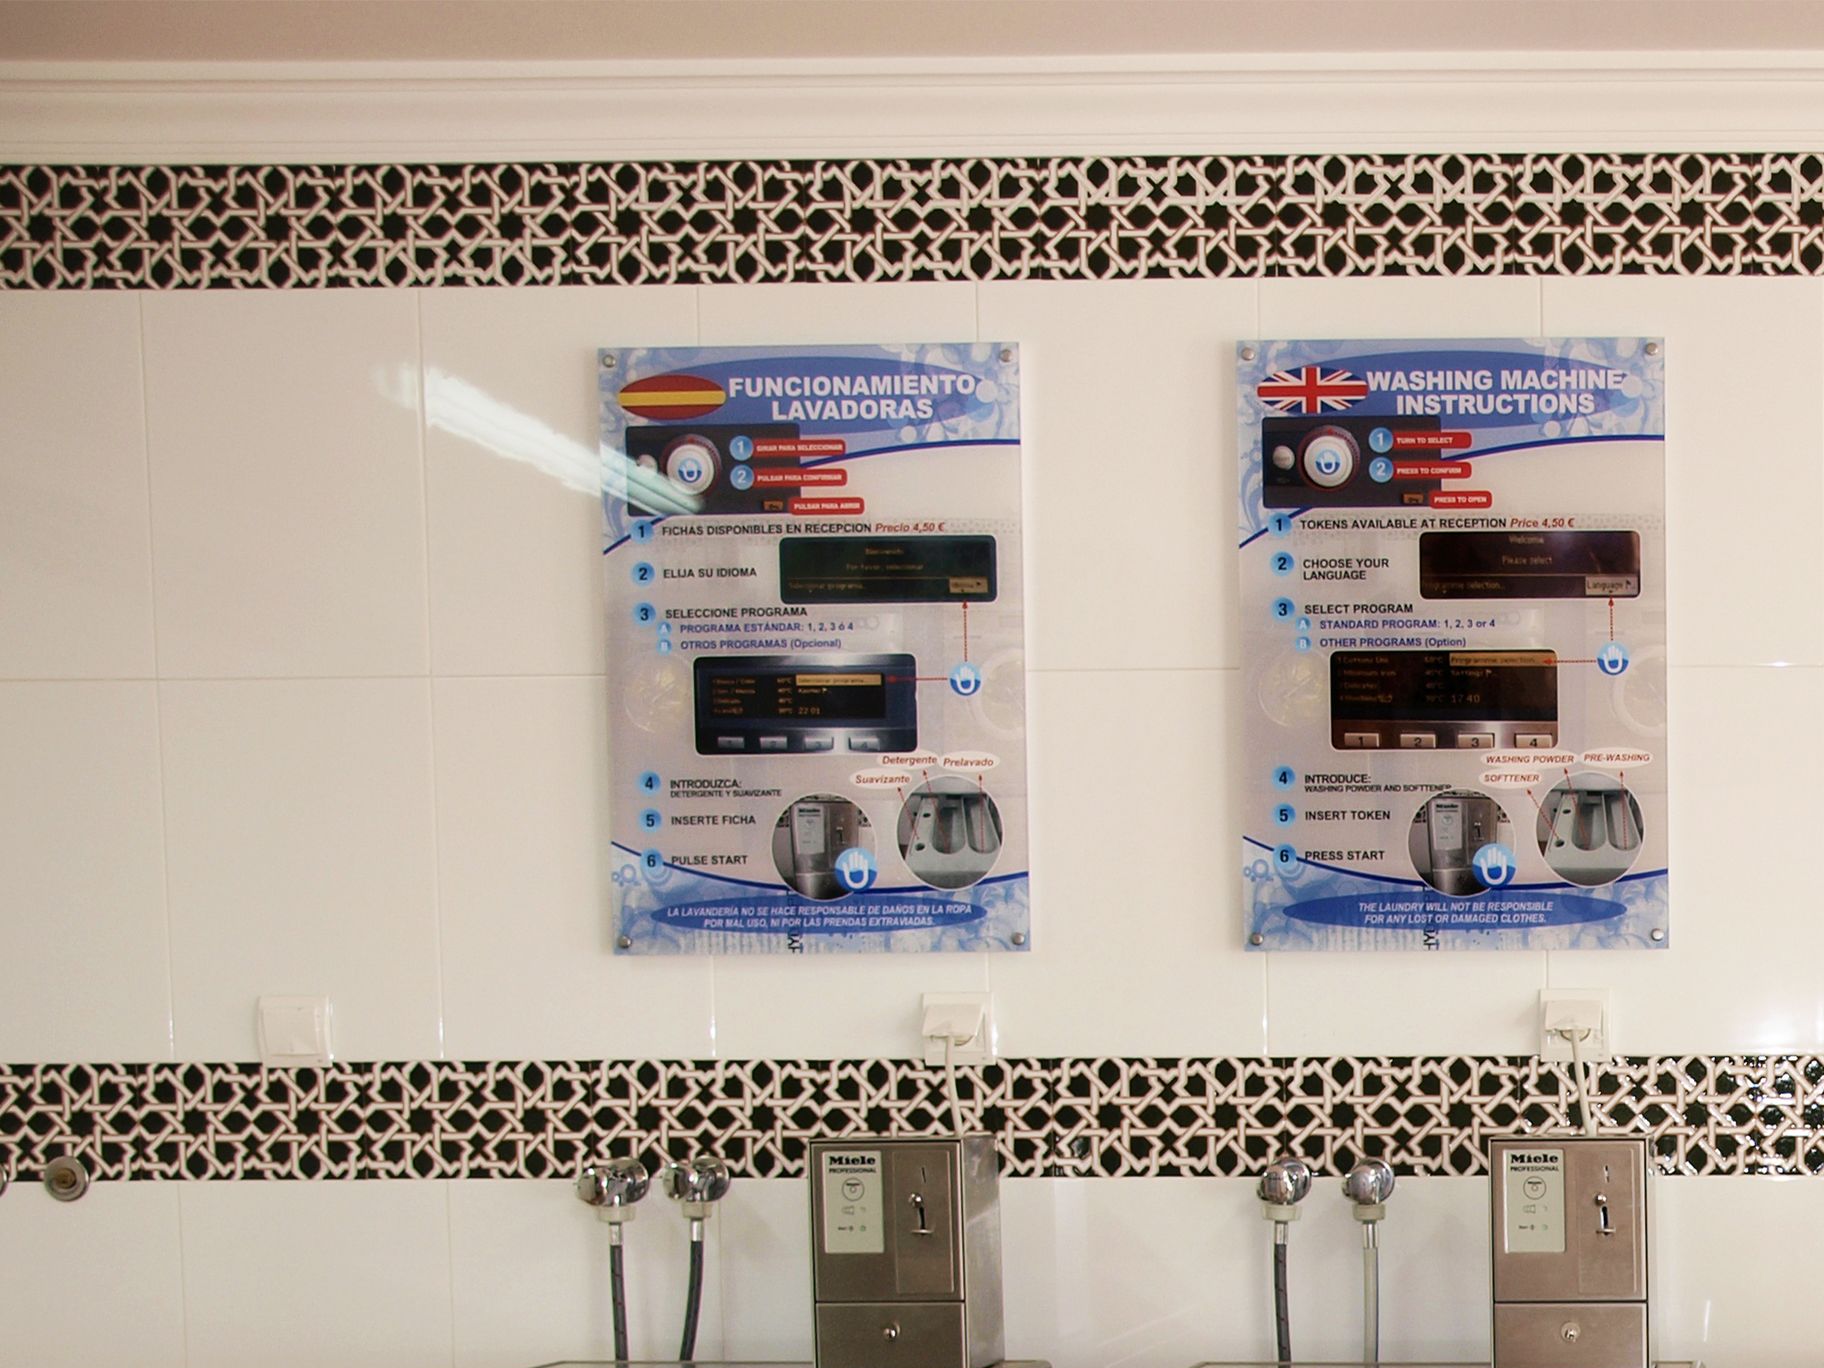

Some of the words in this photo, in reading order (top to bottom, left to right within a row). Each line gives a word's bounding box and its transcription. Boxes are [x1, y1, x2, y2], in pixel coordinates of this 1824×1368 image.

[1366, 370, 1493, 391] WASHING
[1501, 369, 1622, 390] MACHINE
[729, 375, 976, 397] FUNCIONAMIENTO
[1397, 394, 1594, 415] INSTRUCTIONS
[772, 400, 933, 421] LAVADORAS
[1300, 519, 1348, 529] TOKENS
[1352, 519, 1417, 529] AVAILABLE
[1421, 518, 1436, 528] AT
[1439, 518, 1507, 528] RECEPTION
[1510, 517, 1539, 528] Price
[1541, 518, 1564, 529] 4,50
[1567, 518, 1575, 528] €
[662, 526, 706, 536] FICHAS
[709, 524, 783, 536] DISPONIBLES
[786, 524, 802, 534] EN
[804, 523, 871, 534] RECEPCION
[875, 523, 909, 533] Precio
[912, 523, 935, 534] 4,50
[937, 522, 945, 532] €
[1303, 559, 1352, 569] CHOOSE
[1356, 558, 1389, 568] YOUR
[663, 568, 695, 579] ELIJA
[698, 568, 714, 578] SU
[717, 567, 757, 578] IDIOMA
[1303, 570, 1366, 581] LANGUAGE
[666, 608, 738, 619] SELECCIONE
[742, 607, 807, 618] PROGRAMA
[1305, 604, 1347, 614] SELECT
[1351, 603, 1413, 614] PROGRAM
[681, 640, 717, 650] OTROS
[720, 639, 787, 649] PROGRAMAS
[790, 637, 841, 649] (Opcional)
[1320, 637, 1357, 647] OTHER
[1359, 637, 1422, 647] PROGRAMS
[1425, 637, 1466, 648] (Option)
[882, 755, 937, 767] Detergente
[943, 757, 993, 768] Prelavado
[1486, 755, 1530, 763] WASHING
[1533, 755, 1574, 763] POWDER
[1584, 753, 1650, 762] PRE-WASHING
[855, 774, 910, 785] Suavizante
[1305, 774, 1371, 784] INTRODUCE:
[1484, 774, 1540, 783] SOFTTENER
[670, 780, 742, 789] INTRODUZCA:
[1384, 784, 1401, 792] AND
[671, 816, 718, 826] INSERTE
[722, 815, 756, 825] FICHA
[1305, 811, 1347, 820] INSERT
[1350, 810, 1391, 820] TOKEN
[672, 856, 707, 866] PULSE
[711, 855, 747, 865] START
[1305, 851, 1343, 861] PRESS
[1348, 850, 1385, 860] START
[1359, 902, 1376, 911] THE
[1378, 902, 1423, 912] LAUNDRY
[1425, 902, 1448, 911] WILL
[1451, 902, 1470, 911] NOT
[1472, 902, 1486, 911] BE
[1487, 901, 1553, 911] RESPONSIBLE
[1364, 914, 1385, 923] FOR
[1386, 914, 1406, 923] ANY
[1408, 914, 1433, 923] LOST
[1435, 914, 1449, 923] OR
[1451, 913, 1499, 923] DAMAGED
[1500, 913, 1546, 923] CLOTHES.
[829, 1156, 876, 1165] Miele
[1510, 1154, 1558, 1163] Miele
